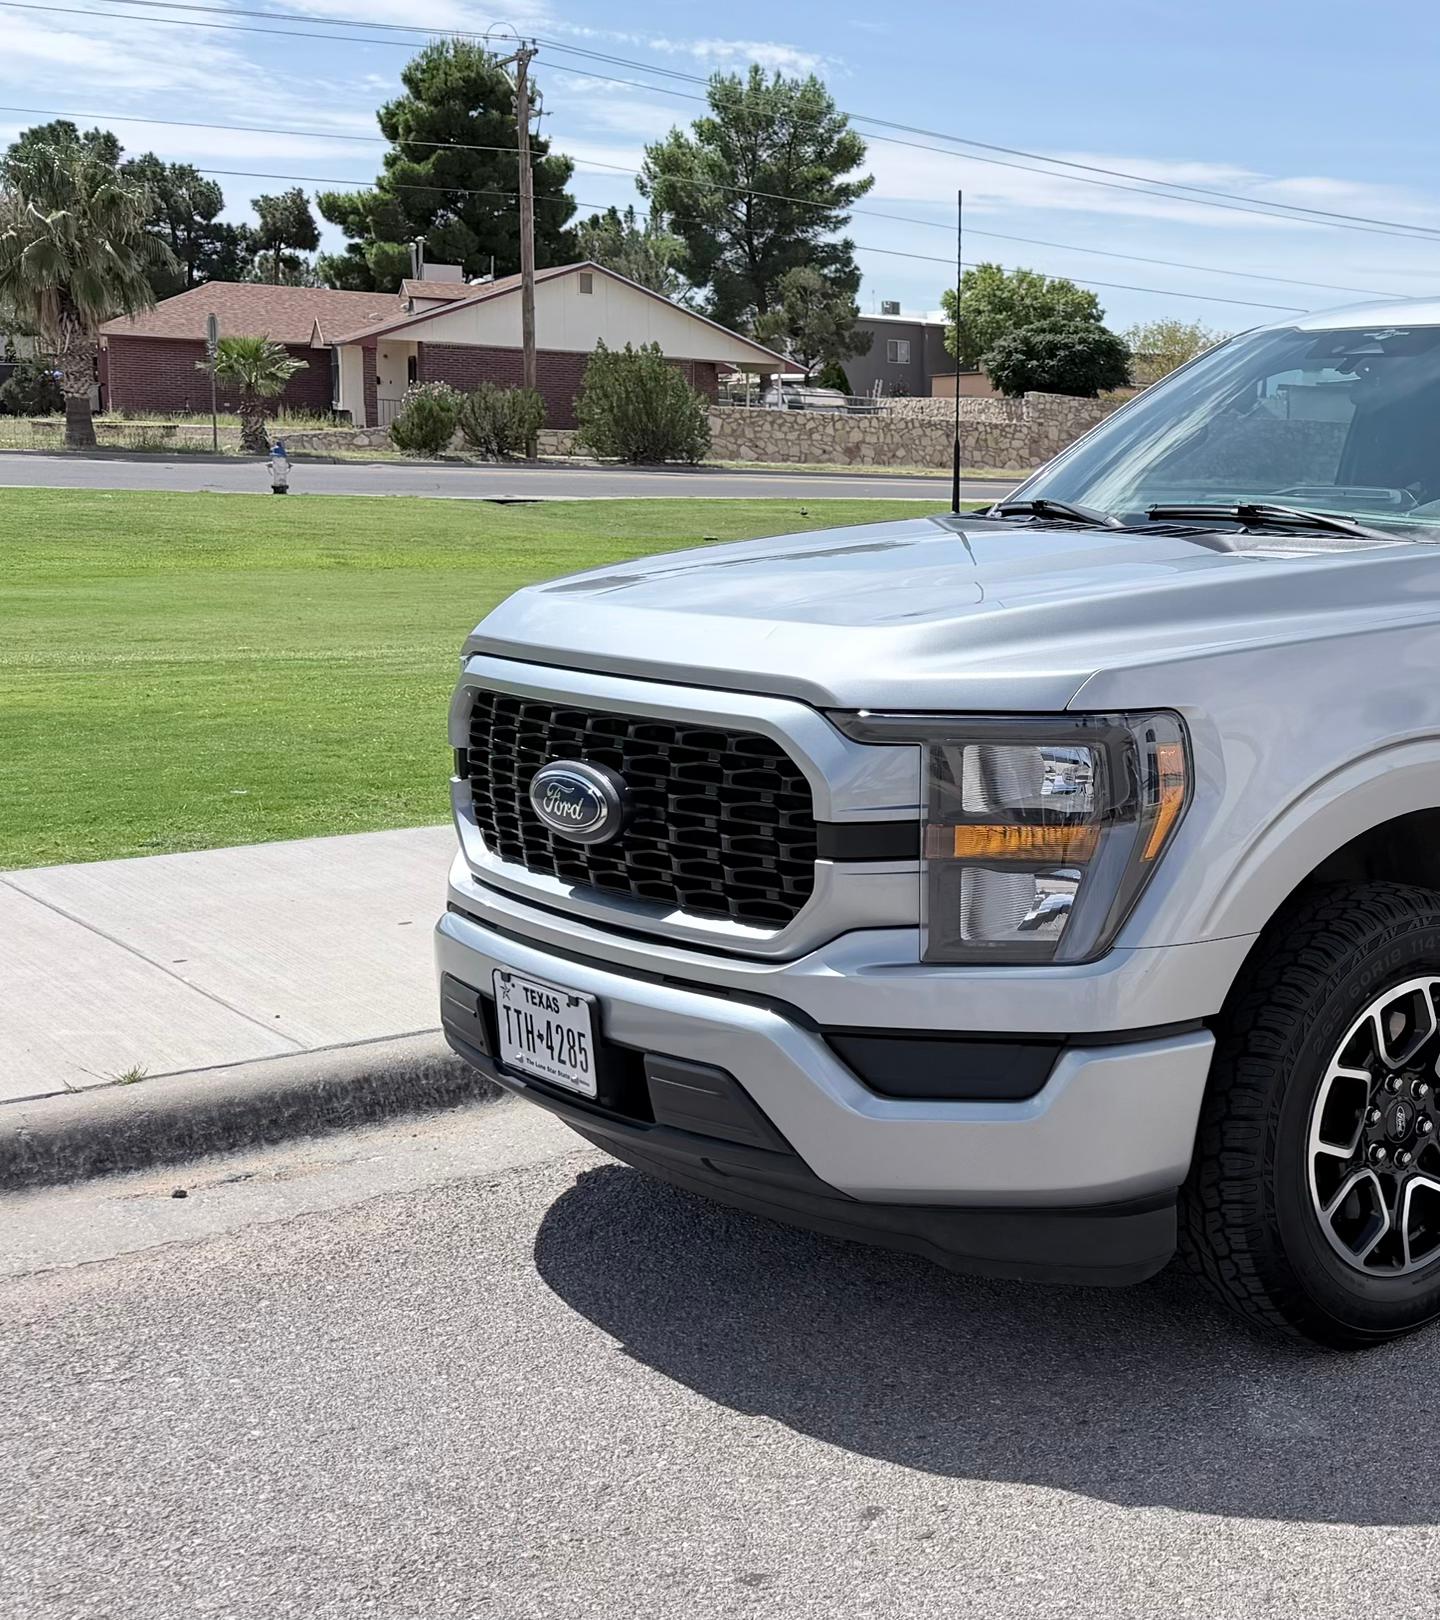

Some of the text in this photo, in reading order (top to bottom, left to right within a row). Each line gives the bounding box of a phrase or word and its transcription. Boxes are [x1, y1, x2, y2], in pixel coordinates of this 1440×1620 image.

[543, 782, 585, 820] Ford
[522, 986, 560, 1014] TEXAS
[526, 1057, 535, 1066] The
[535, 1061, 546, 1071] Lone
[546, 1065, 557, 1075] Star
